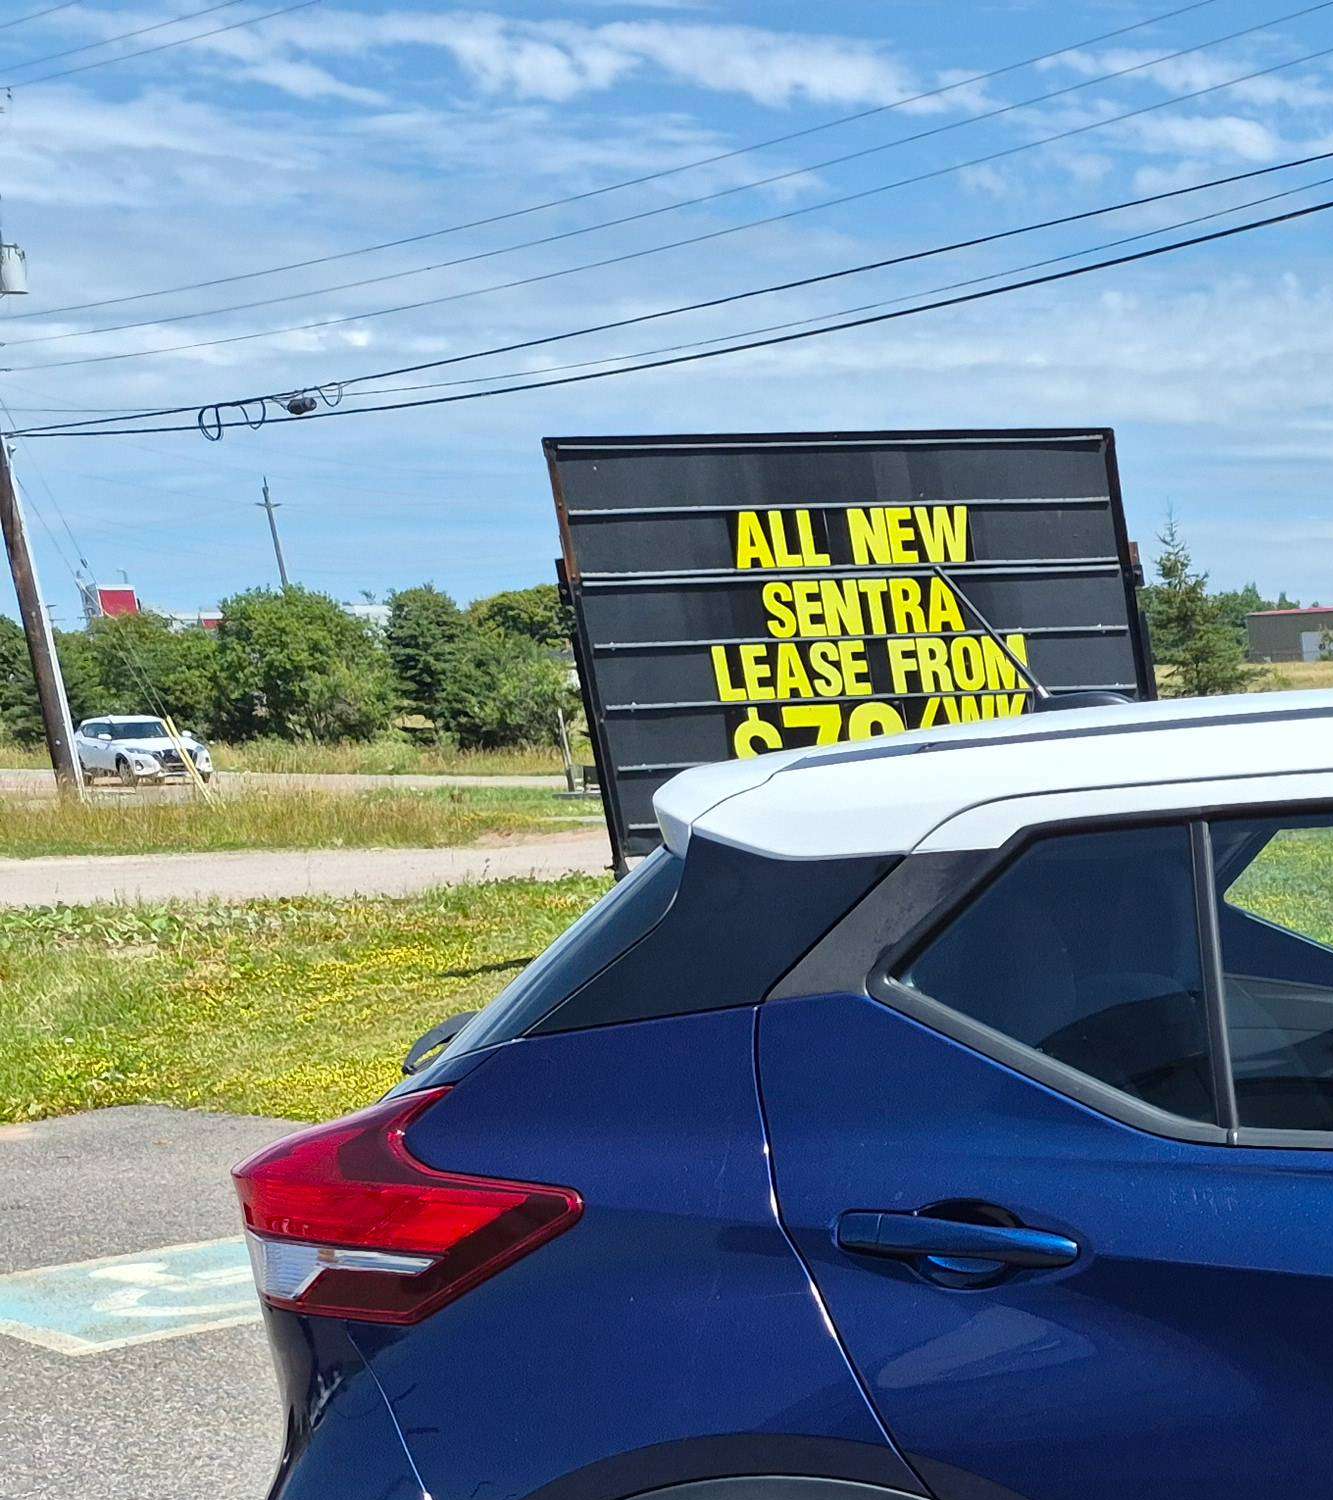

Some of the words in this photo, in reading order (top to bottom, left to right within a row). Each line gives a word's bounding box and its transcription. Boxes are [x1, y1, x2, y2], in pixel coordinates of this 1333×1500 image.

[736, 509, 831, 570] ALL
[847, 506, 967, 566] NEW
[762, 577, 966, 638] SENTRA
[712, 640, 873, 702] LEASE
[887, 633, 1028, 694] FROM
